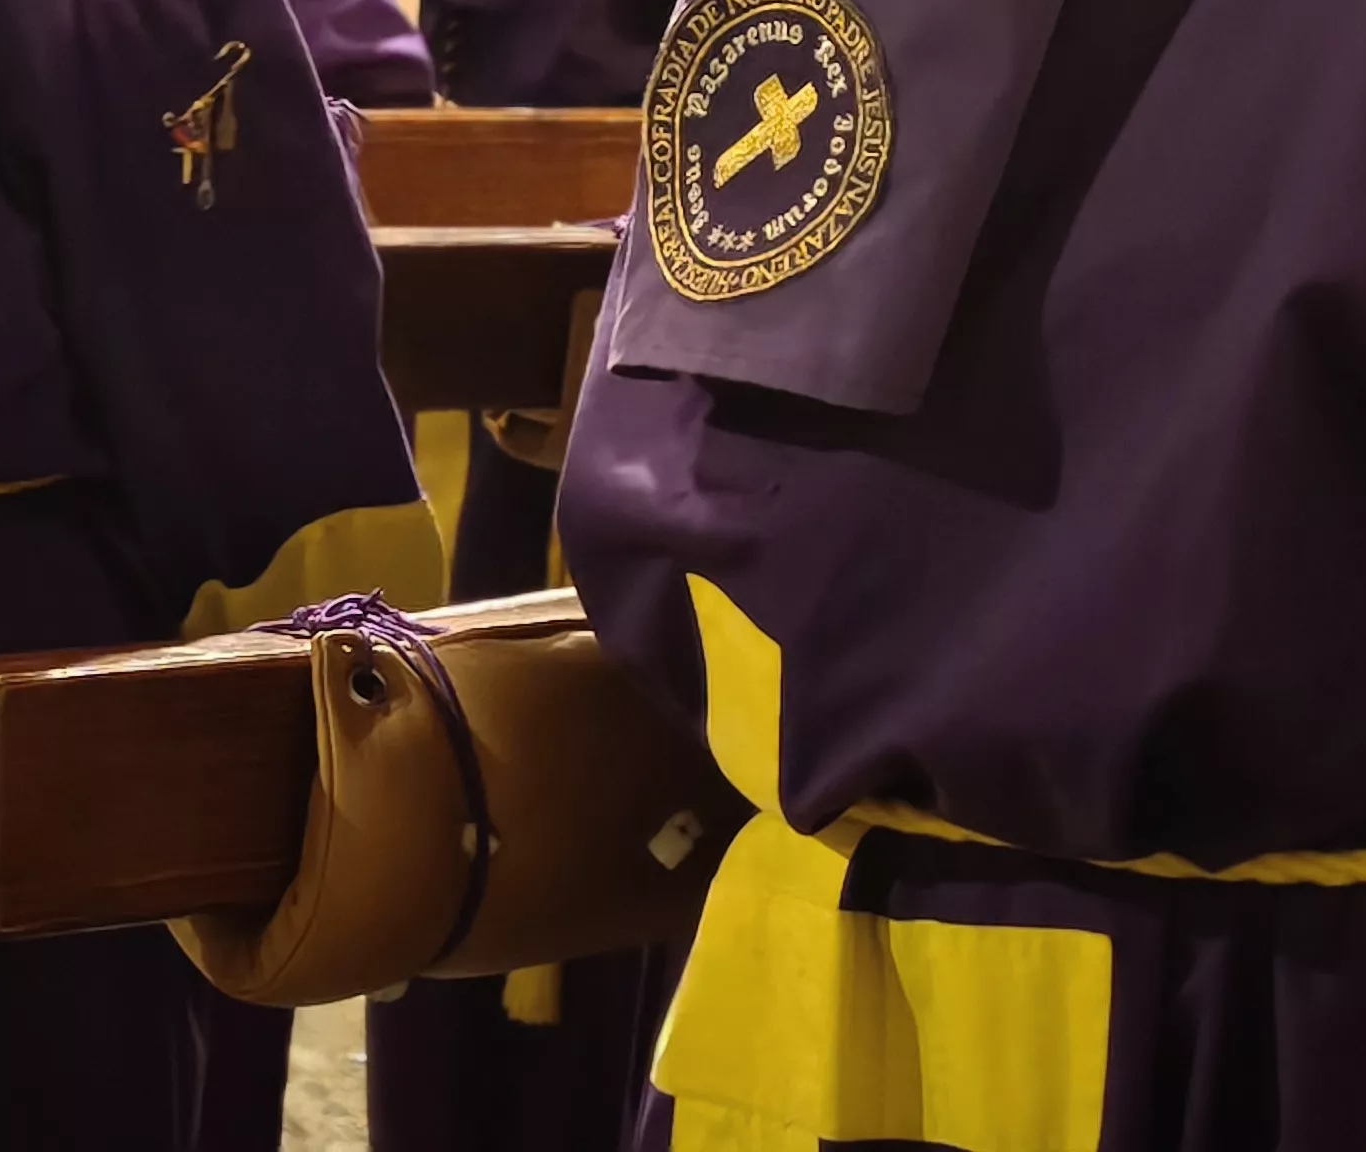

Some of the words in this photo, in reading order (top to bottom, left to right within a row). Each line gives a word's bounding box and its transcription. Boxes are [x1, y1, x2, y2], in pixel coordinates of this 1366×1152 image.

[689, 4, 725, 44] DE
[651, 40, 697, 183] COFRADIA
[654, 183, 682, 257] REAL
[741, 176, 873, 288] NAZARENO
